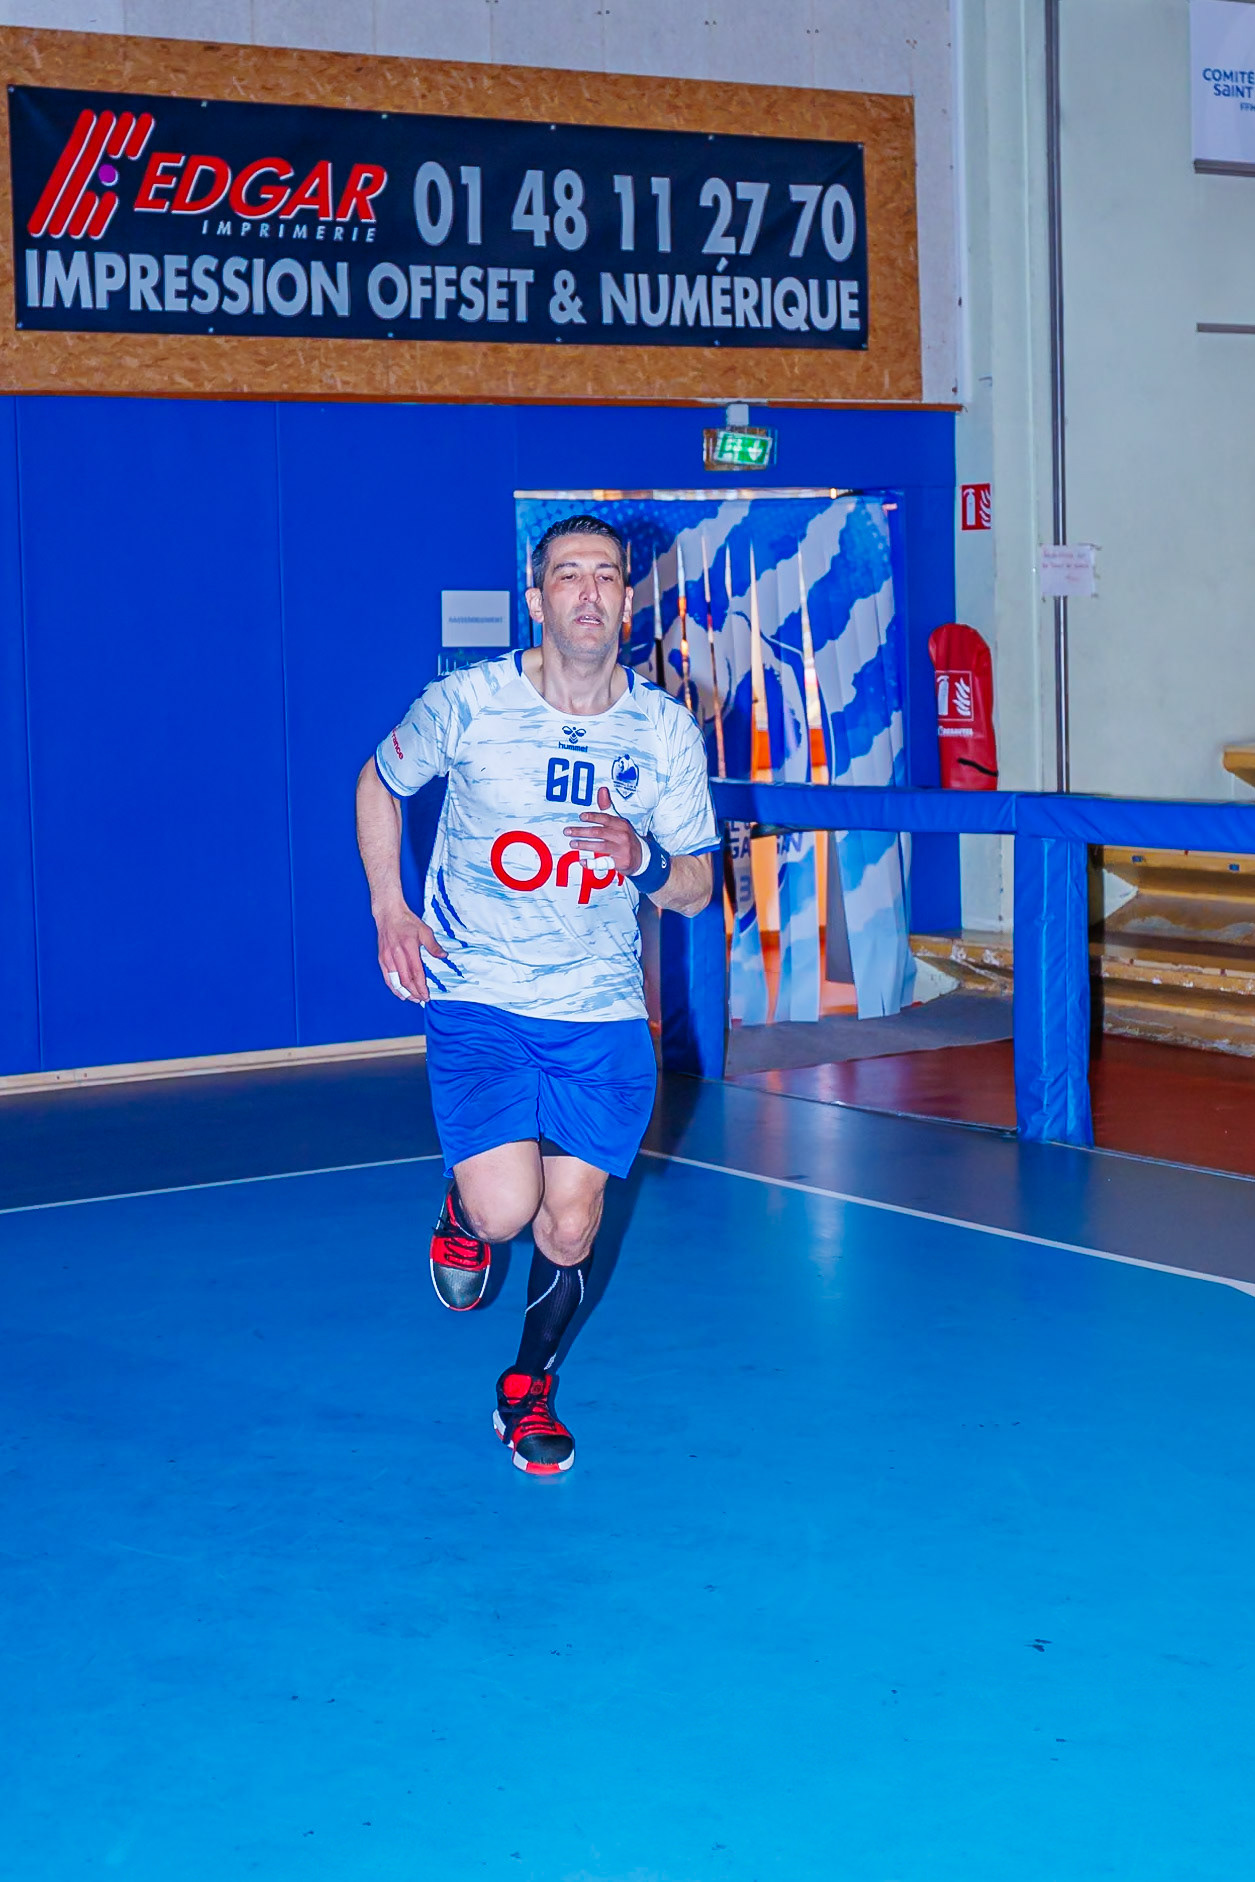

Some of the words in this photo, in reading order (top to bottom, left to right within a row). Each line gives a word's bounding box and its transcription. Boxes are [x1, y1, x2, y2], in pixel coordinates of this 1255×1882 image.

[134, 151, 387, 222] EDGAR
[413, 161, 482, 246] 01
[512, 169, 588, 251] 48
[613, 174, 671, 253] 11
[699, 177, 770, 254] 27
[788, 183, 856, 262] 70
[201, 220, 377, 243] IMPRIMERIE
[25, 248, 351, 317] IMPRESSION
[367, 262, 535, 323] OFFSET
[549, 269, 587, 324] &
[600, 257, 861, 332] NUMÉRIQUE
[546, 757, 595, 807] 60
[558, 740, 589, 753] hummel
[490, 830, 625, 905] Orp
